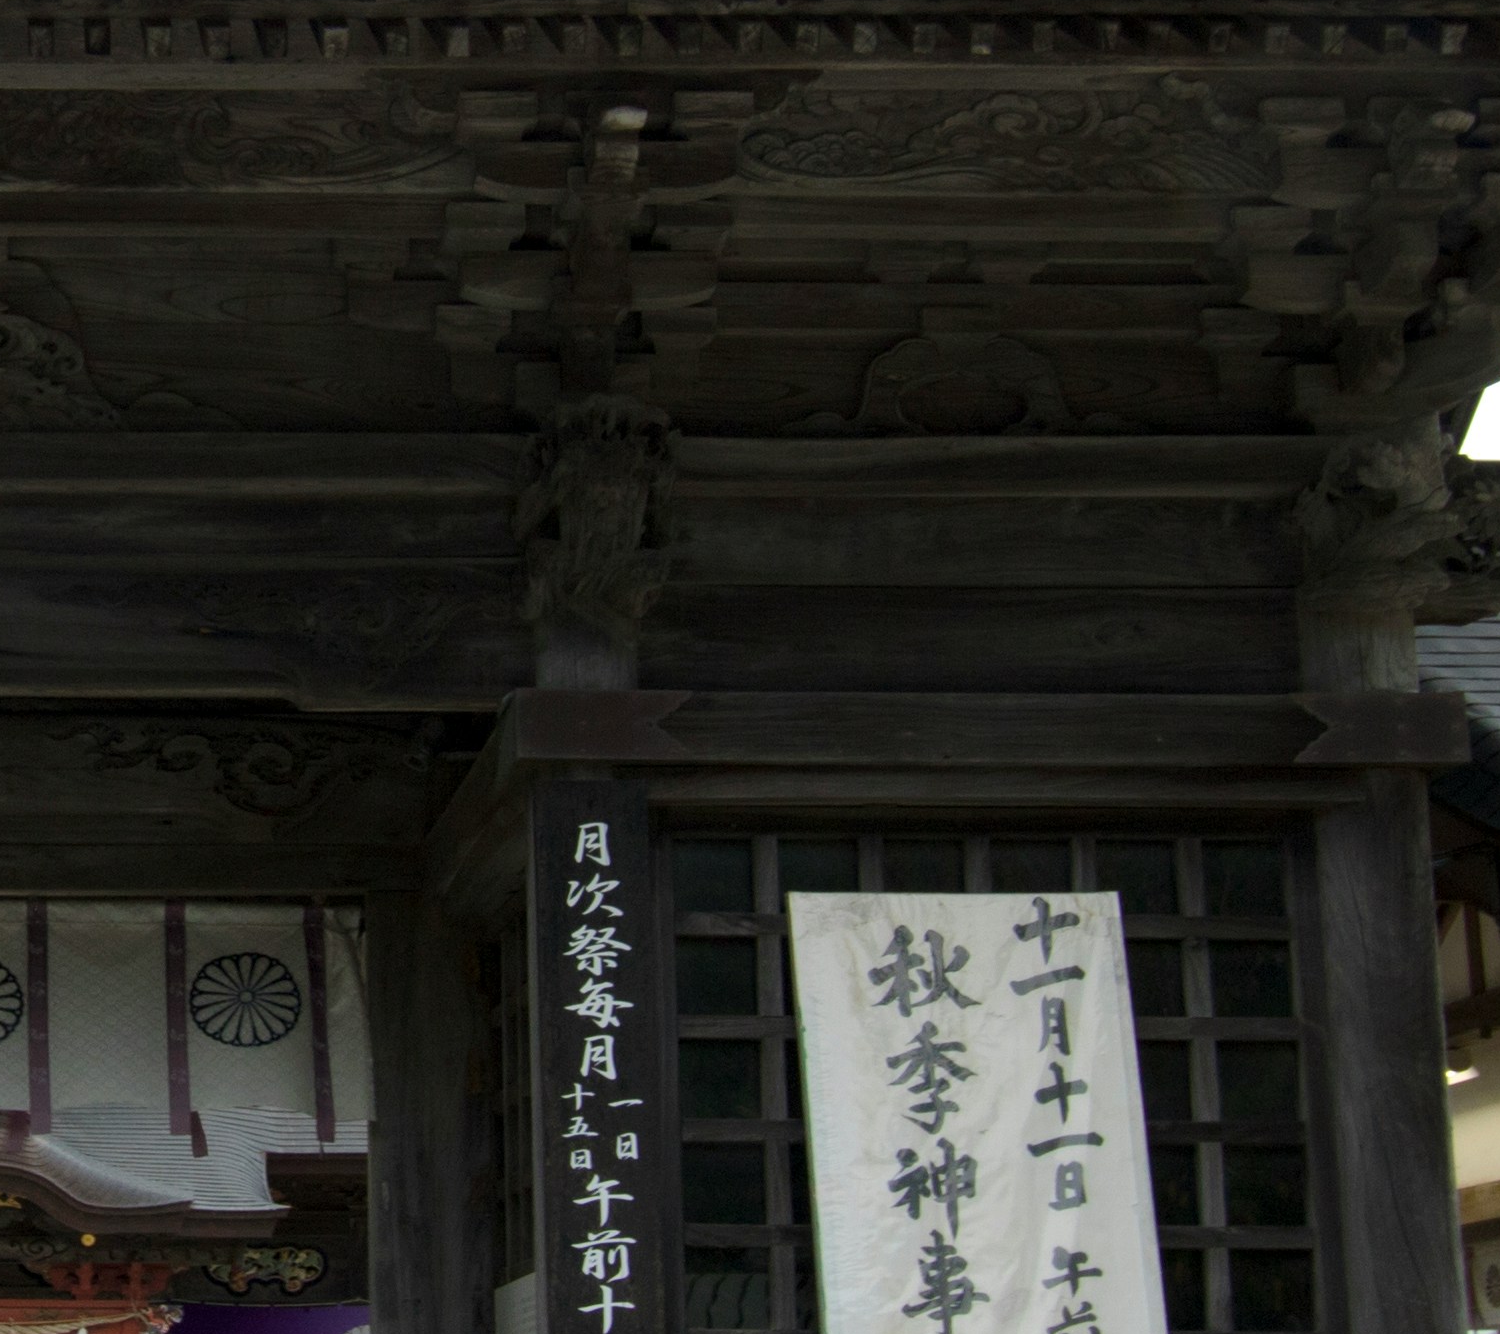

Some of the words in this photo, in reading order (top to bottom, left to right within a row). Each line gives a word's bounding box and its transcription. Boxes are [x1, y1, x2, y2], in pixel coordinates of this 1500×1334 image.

[562, 821, 634, 1081] 月次祭毎月
[561, 1082, 599, 1170] 十五日
[608, 1098, 644, 1160] 一日
[1011, 896, 1104, 1211] 十一月十一日
